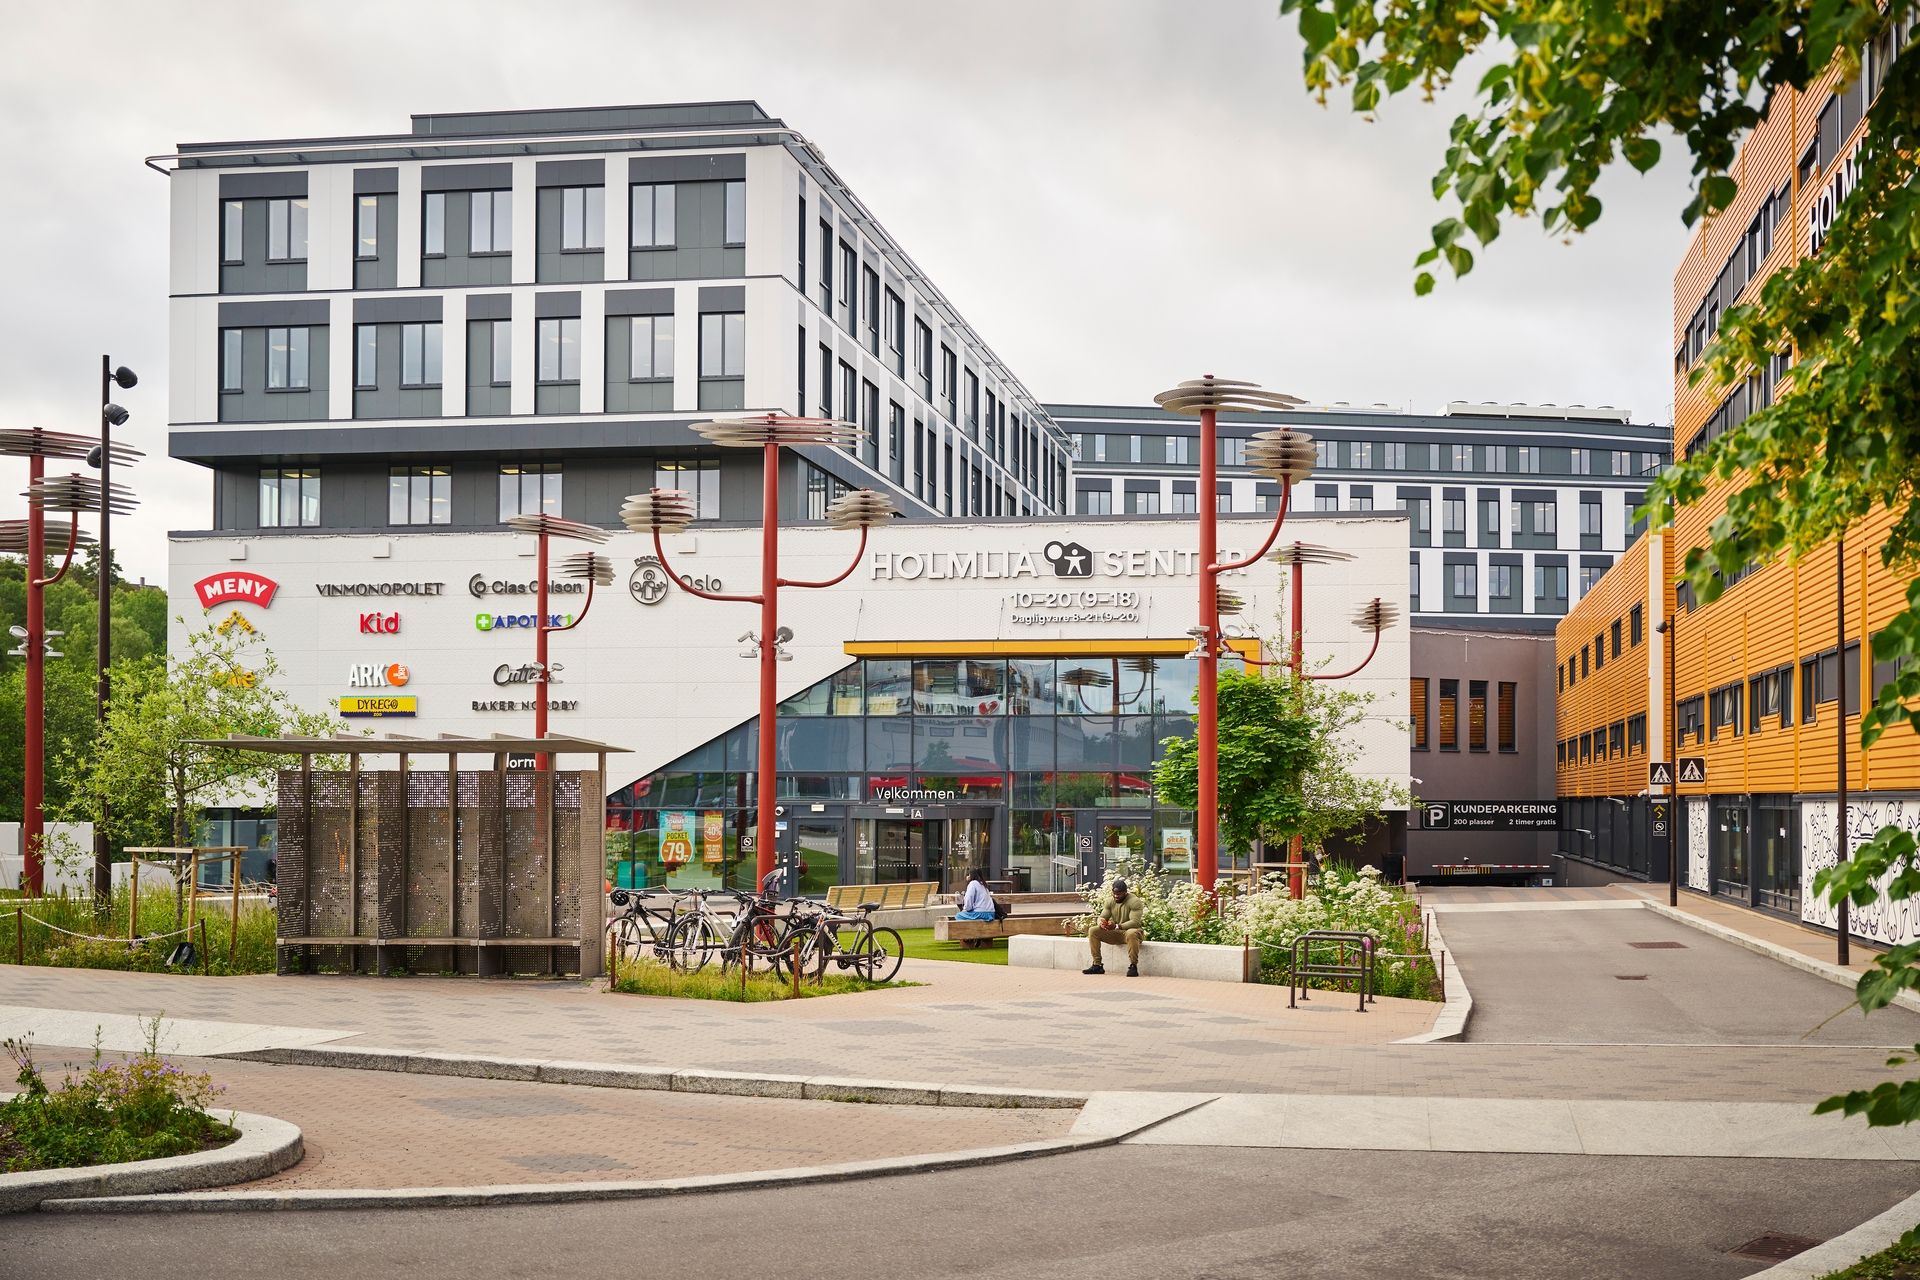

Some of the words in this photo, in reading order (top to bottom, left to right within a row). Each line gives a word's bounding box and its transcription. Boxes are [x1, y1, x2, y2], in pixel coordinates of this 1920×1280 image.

[871, 551, 1039, 580] HOLMLIA
[1102, 549, 1247, 577] SENTR
[204, 578, 268, 599] MENY
[316, 583, 444, 596] VINMONOPOLET
[491, 580, 527, 594] Clas
[529, 580, 583, 594] Olson
[680, 574, 723, 592] Oslo
[360, 612, 399, 634] Kid
[493, 614, 562, 628] APOTK
[1012, 613, 1071, 625] Dagligvare
[349, 664, 388, 687] ARK
[471, 701, 515, 711] BAKER
[521, 700, 577, 711] NDBY
[876, 787, 955, 800] Velkommen
[1453, 804, 1557, 814] KUNDEPARKERING
[1430, 809, 1444, 826] P
[1469, 818, 1495, 827] plasser
[1535, 818, 1557, 828] gratis
[666, 832, 688, 840] POCKET
